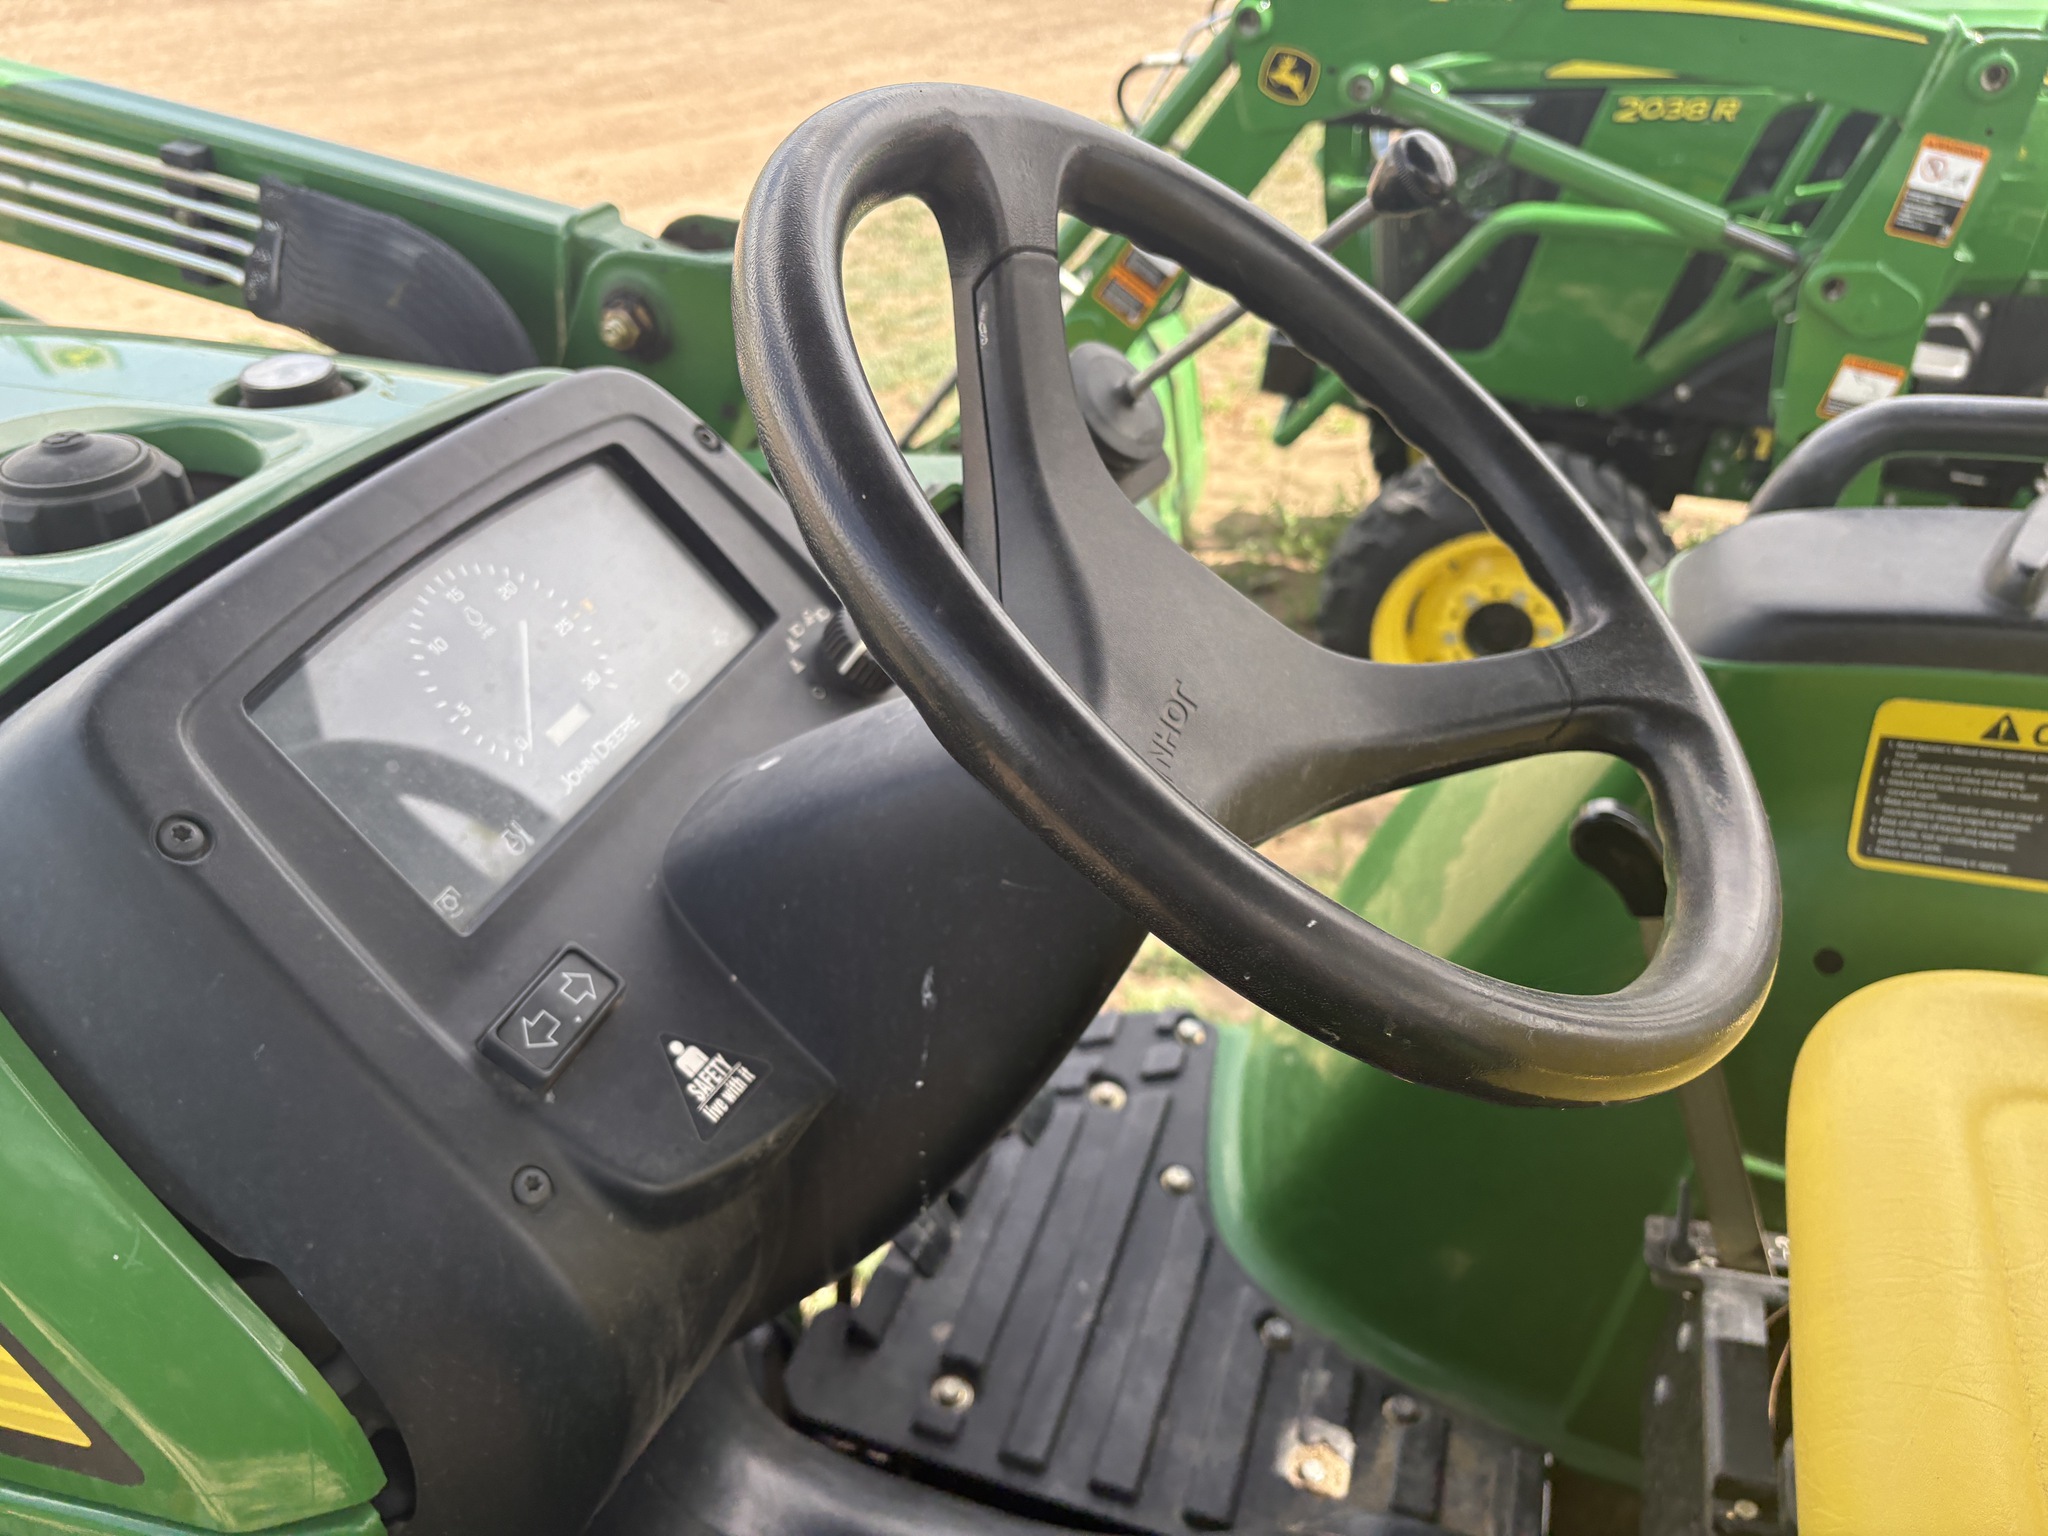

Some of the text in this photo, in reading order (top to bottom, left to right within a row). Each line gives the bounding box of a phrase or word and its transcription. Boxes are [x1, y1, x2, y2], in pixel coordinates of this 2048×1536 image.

[445, 585, 465, 604] 15
[496, 580, 519, 601] 20
[554, 616, 574, 637] 25
[427, 635, 449, 655] 10
[581, 669, 601, 691] 30
[456, 701, 472, 717] 5
[1147, 678, 1198, 769] JOHN
[686, 1052, 733, 1102] SAFETY
[721, 1075, 748, 1106] with
